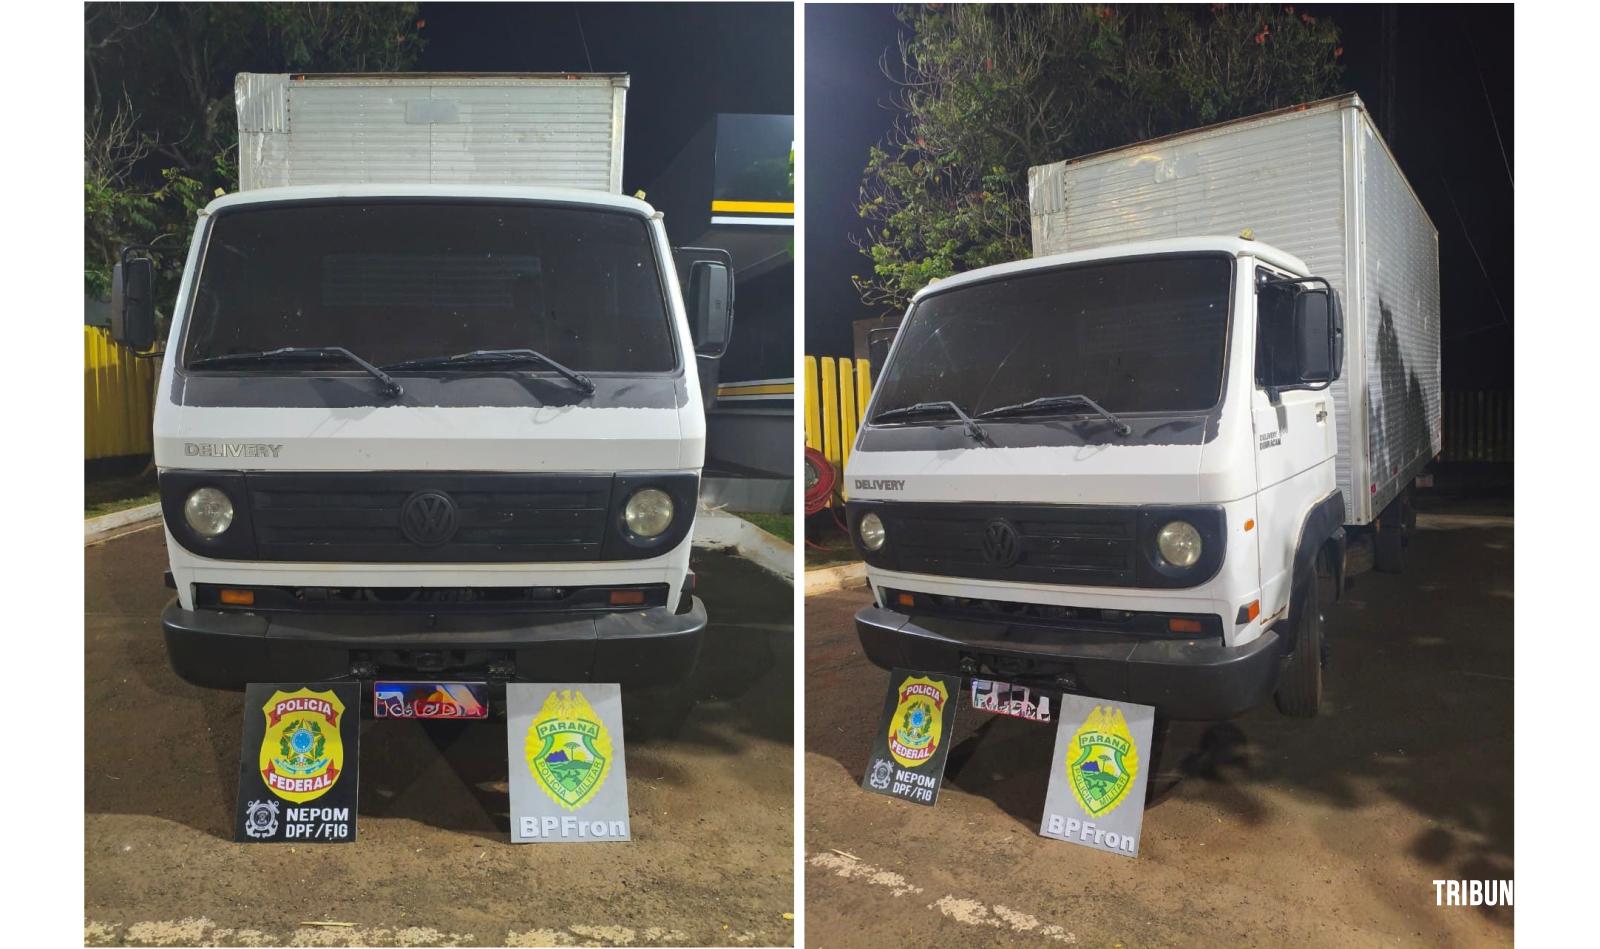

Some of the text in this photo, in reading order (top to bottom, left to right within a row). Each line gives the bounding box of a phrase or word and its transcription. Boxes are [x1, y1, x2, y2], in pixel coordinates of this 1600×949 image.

[183, 442, 283, 458] DELIVERY
[854, 479, 906, 491] DELIVERY
[540, 721, 596, 735] PARANÁ
[891, 739, 930, 759] FEDERAL
[1081, 735, 1127, 751] PARANÁ
[269, 772, 332, 792] FEDERAL
[575, 760, 602, 797] MILITAR
[895, 769, 936, 789] NEPOM
[1099, 776, 1126, 807] MILITAR
[286, 807, 349, 822] NEPOM
[285, 823, 348, 839] DPF/FIG
[519, 815, 626, 839] BPFron
[1047, 813, 1136, 852] BPFron
